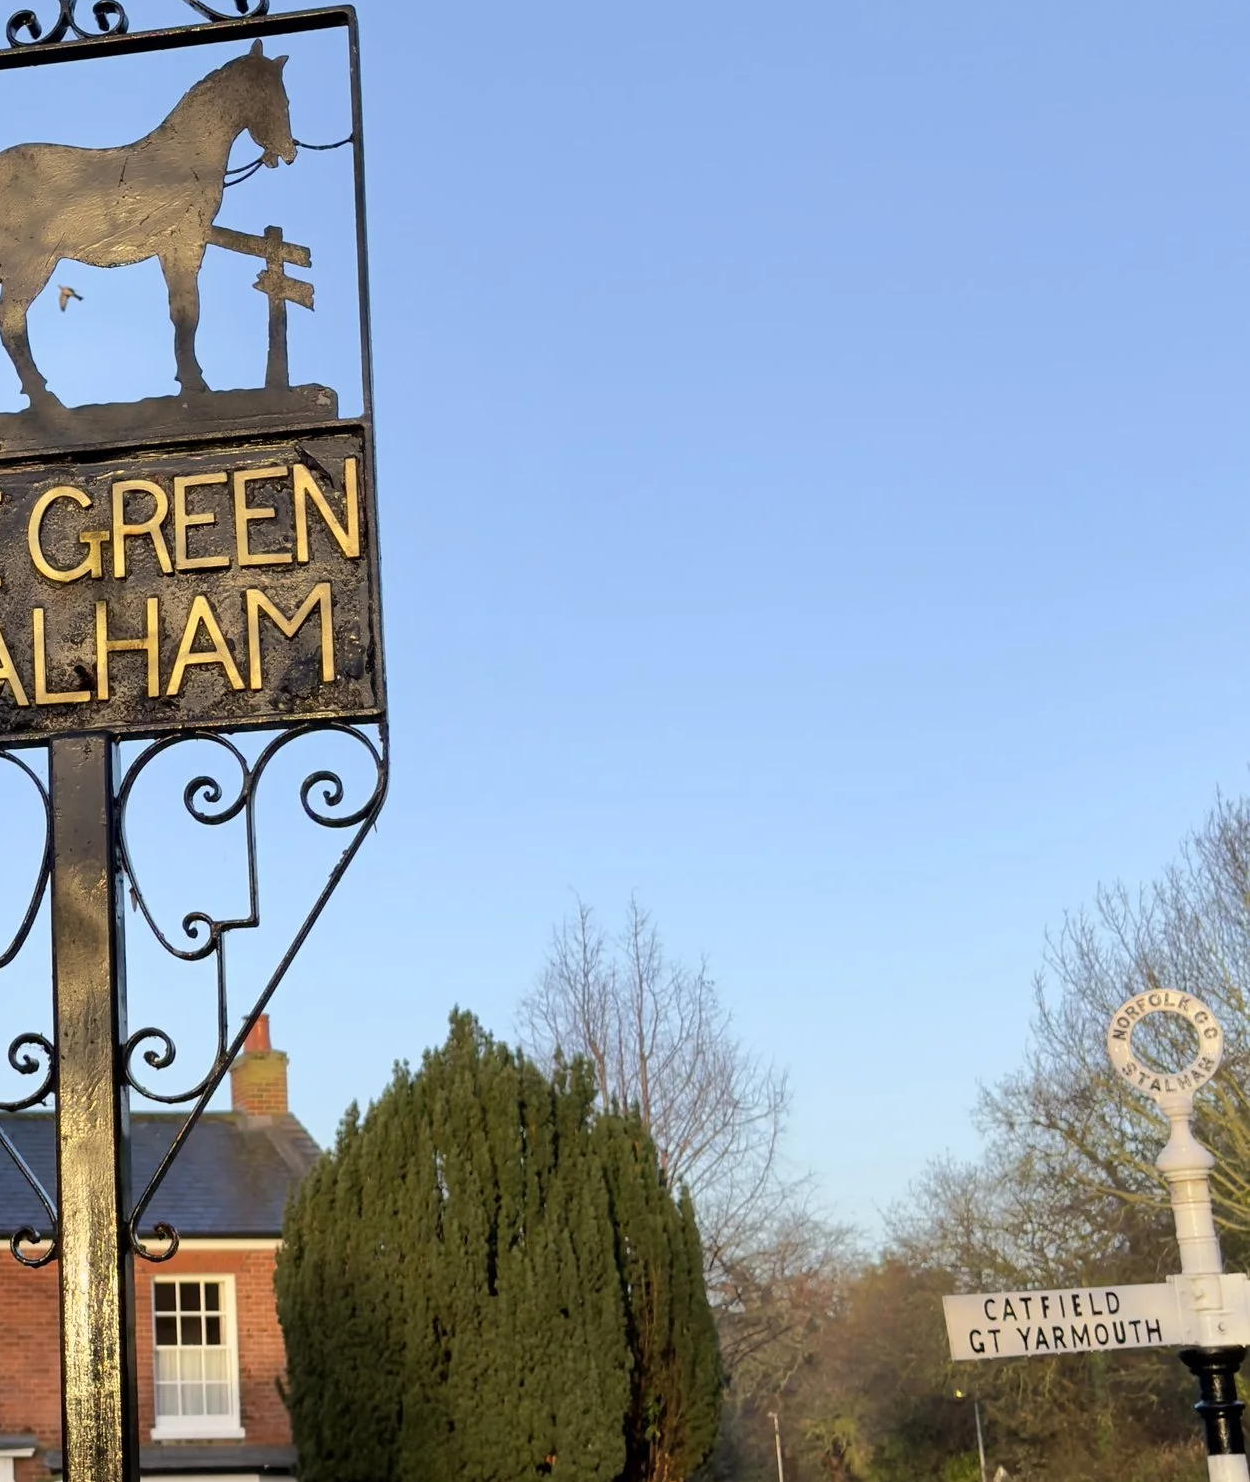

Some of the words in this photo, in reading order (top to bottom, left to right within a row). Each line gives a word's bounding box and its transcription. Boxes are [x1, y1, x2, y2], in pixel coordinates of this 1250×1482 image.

[28, 457, 360, 583] GREEN
[1112, 992, 1191, 1041] NORFOLK
[1122, 1057, 1215, 1092] STALHAM
[984, 1292, 1120, 1321] CATFIELD
[969, 1329, 1001, 1354] GT
[1017, 1319, 1163, 1351] YARMOUTH
